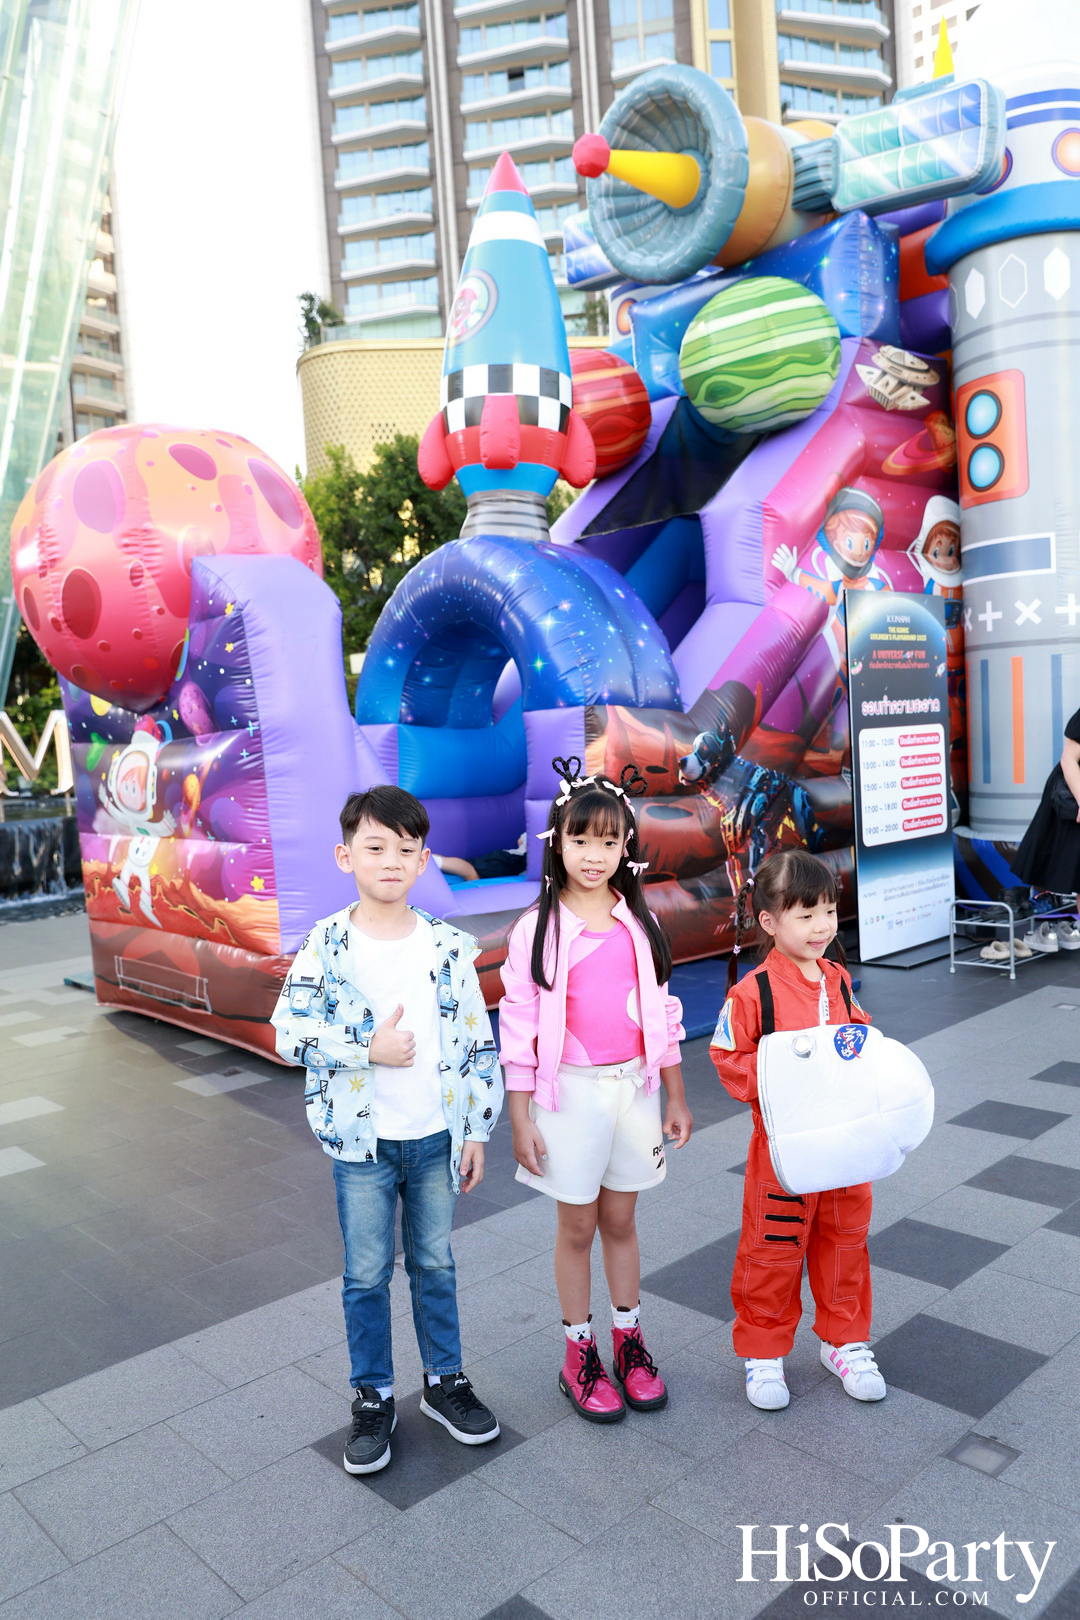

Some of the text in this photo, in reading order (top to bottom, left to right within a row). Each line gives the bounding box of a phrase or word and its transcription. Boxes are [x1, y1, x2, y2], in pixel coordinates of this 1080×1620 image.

[872, 650, 877, 659] A
[878, 650, 903, 659] UNIVERSE
[915, 650, 925, 659] FUN
[861, 695, 940, 716] รอบทำความสะอาด
[862, 740, 875, 748] 11:00
[881, 738, 895, 746] 12:00
[882, 759, 896, 767] 14:00
[864, 783, 877, 792] 15:00
[883, 781, 897, 789] 16:00
[865, 805, 878, 814] 17:00
[884, 802, 898, 811] 18:00
[866, 826, 879, 835] 19:00
[885, 823, 899, 832] 20:00
[455, 1378, 468, 1386] FILA
